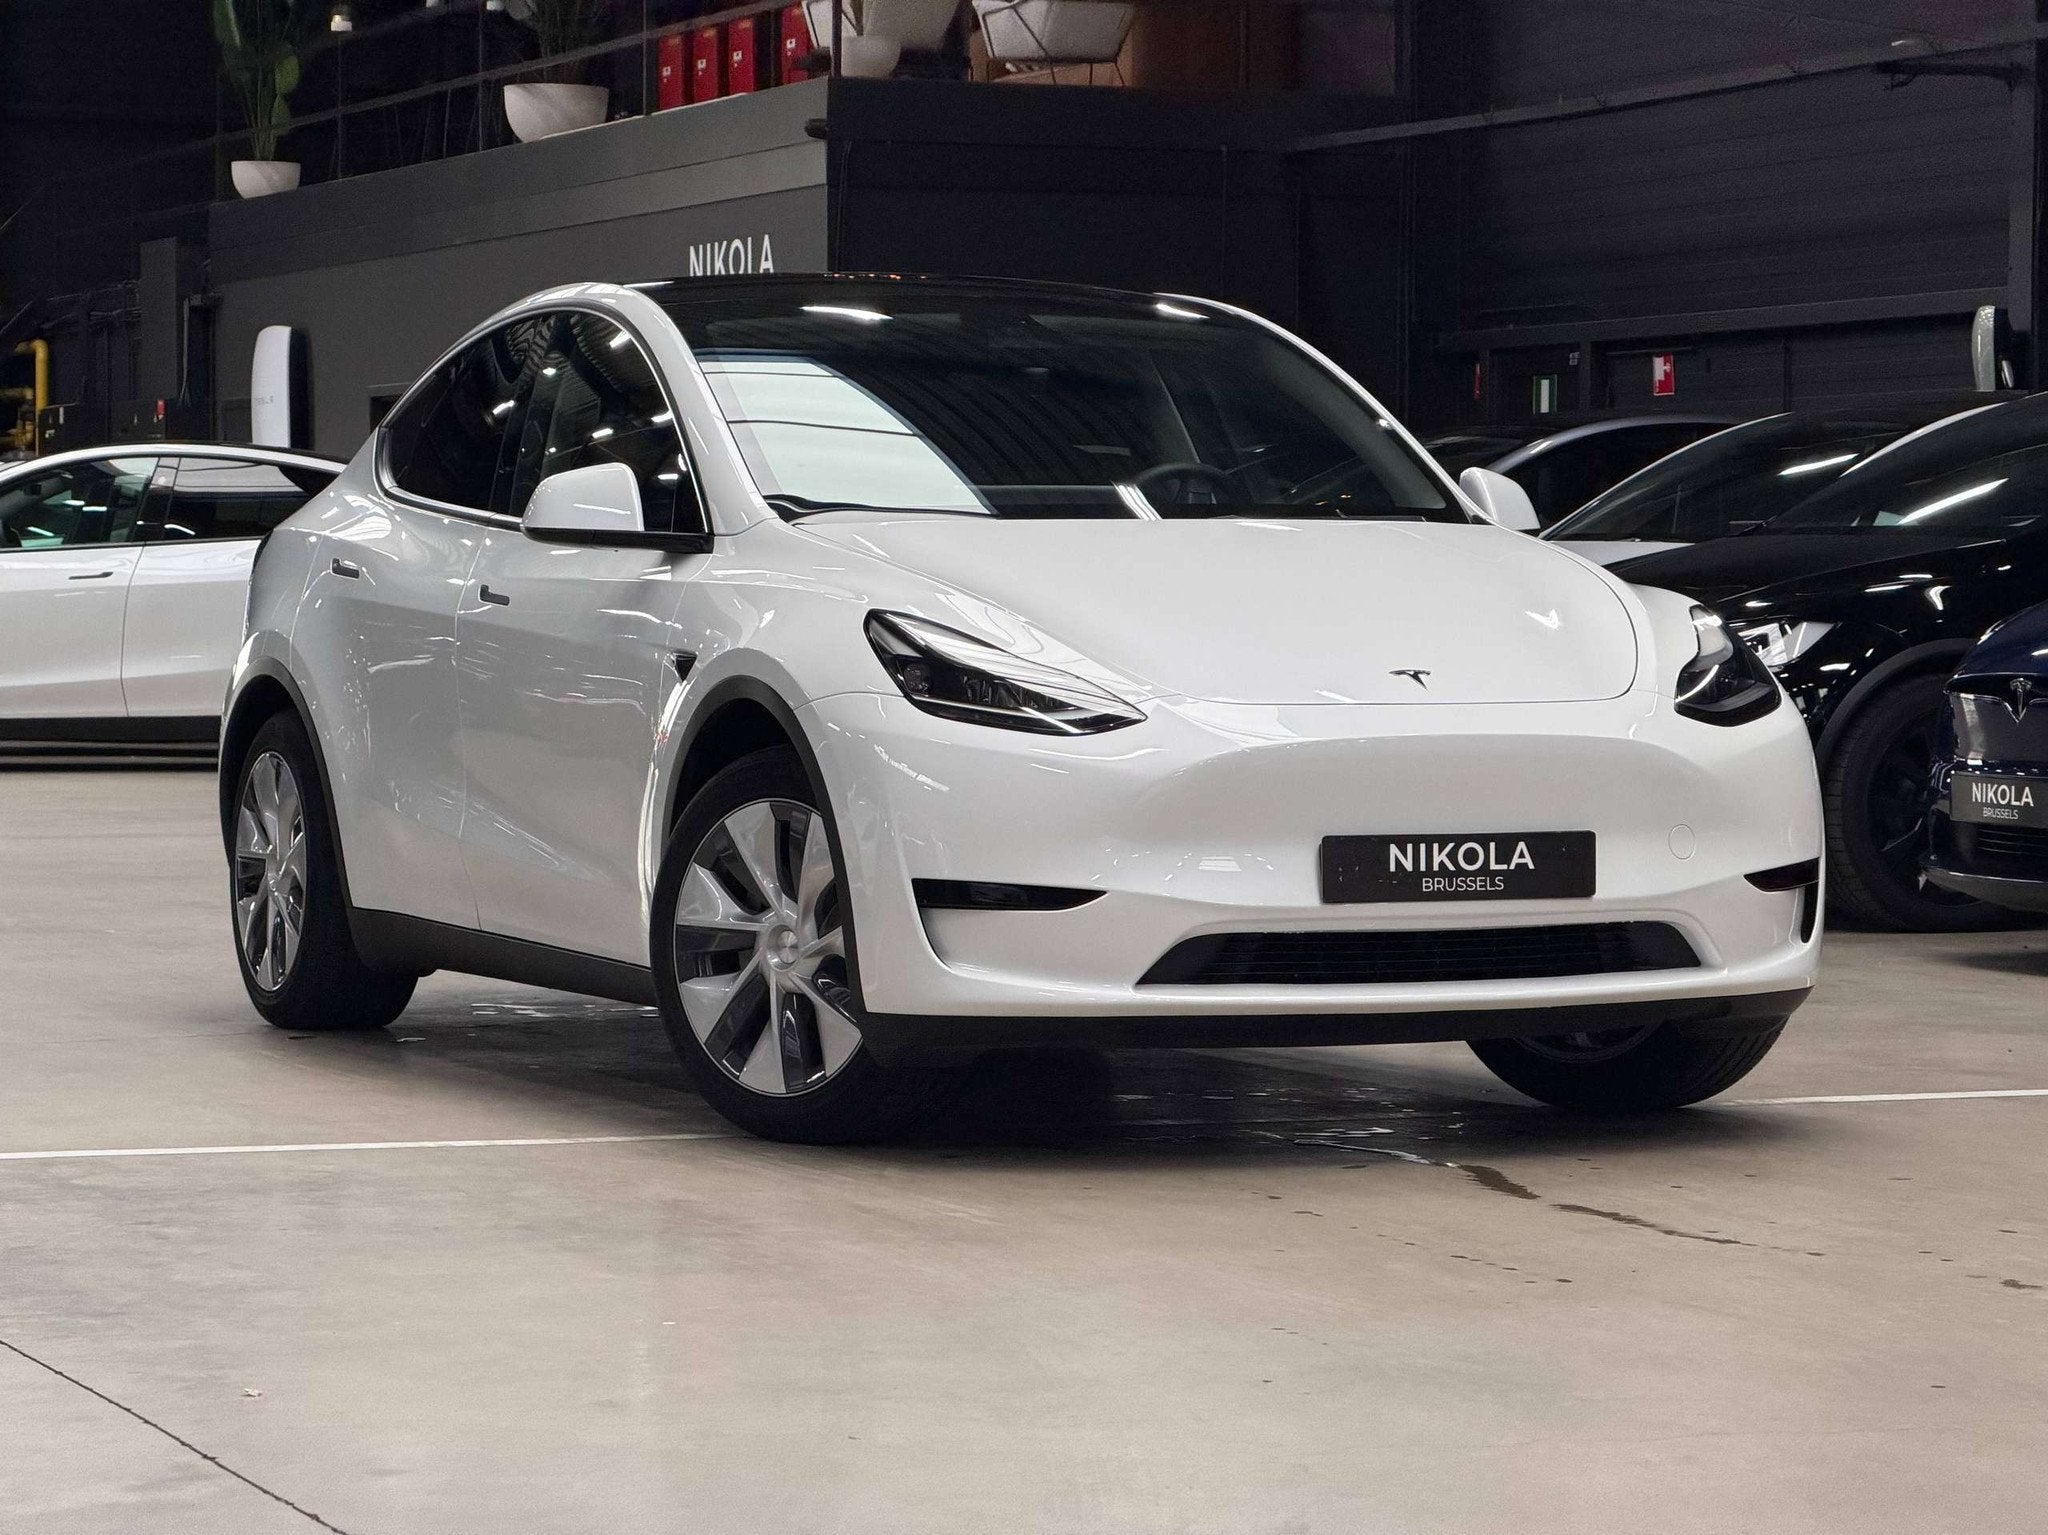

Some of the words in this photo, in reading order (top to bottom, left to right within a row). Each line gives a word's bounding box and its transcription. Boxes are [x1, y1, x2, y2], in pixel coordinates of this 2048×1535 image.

[1972, 782, 2034, 807] NIKOLA
[1982, 807, 2019, 820] BRUSSELS
[1389, 841, 1535, 872] NIKOLA
[1422, 876, 1505, 892] BRUSSELS
